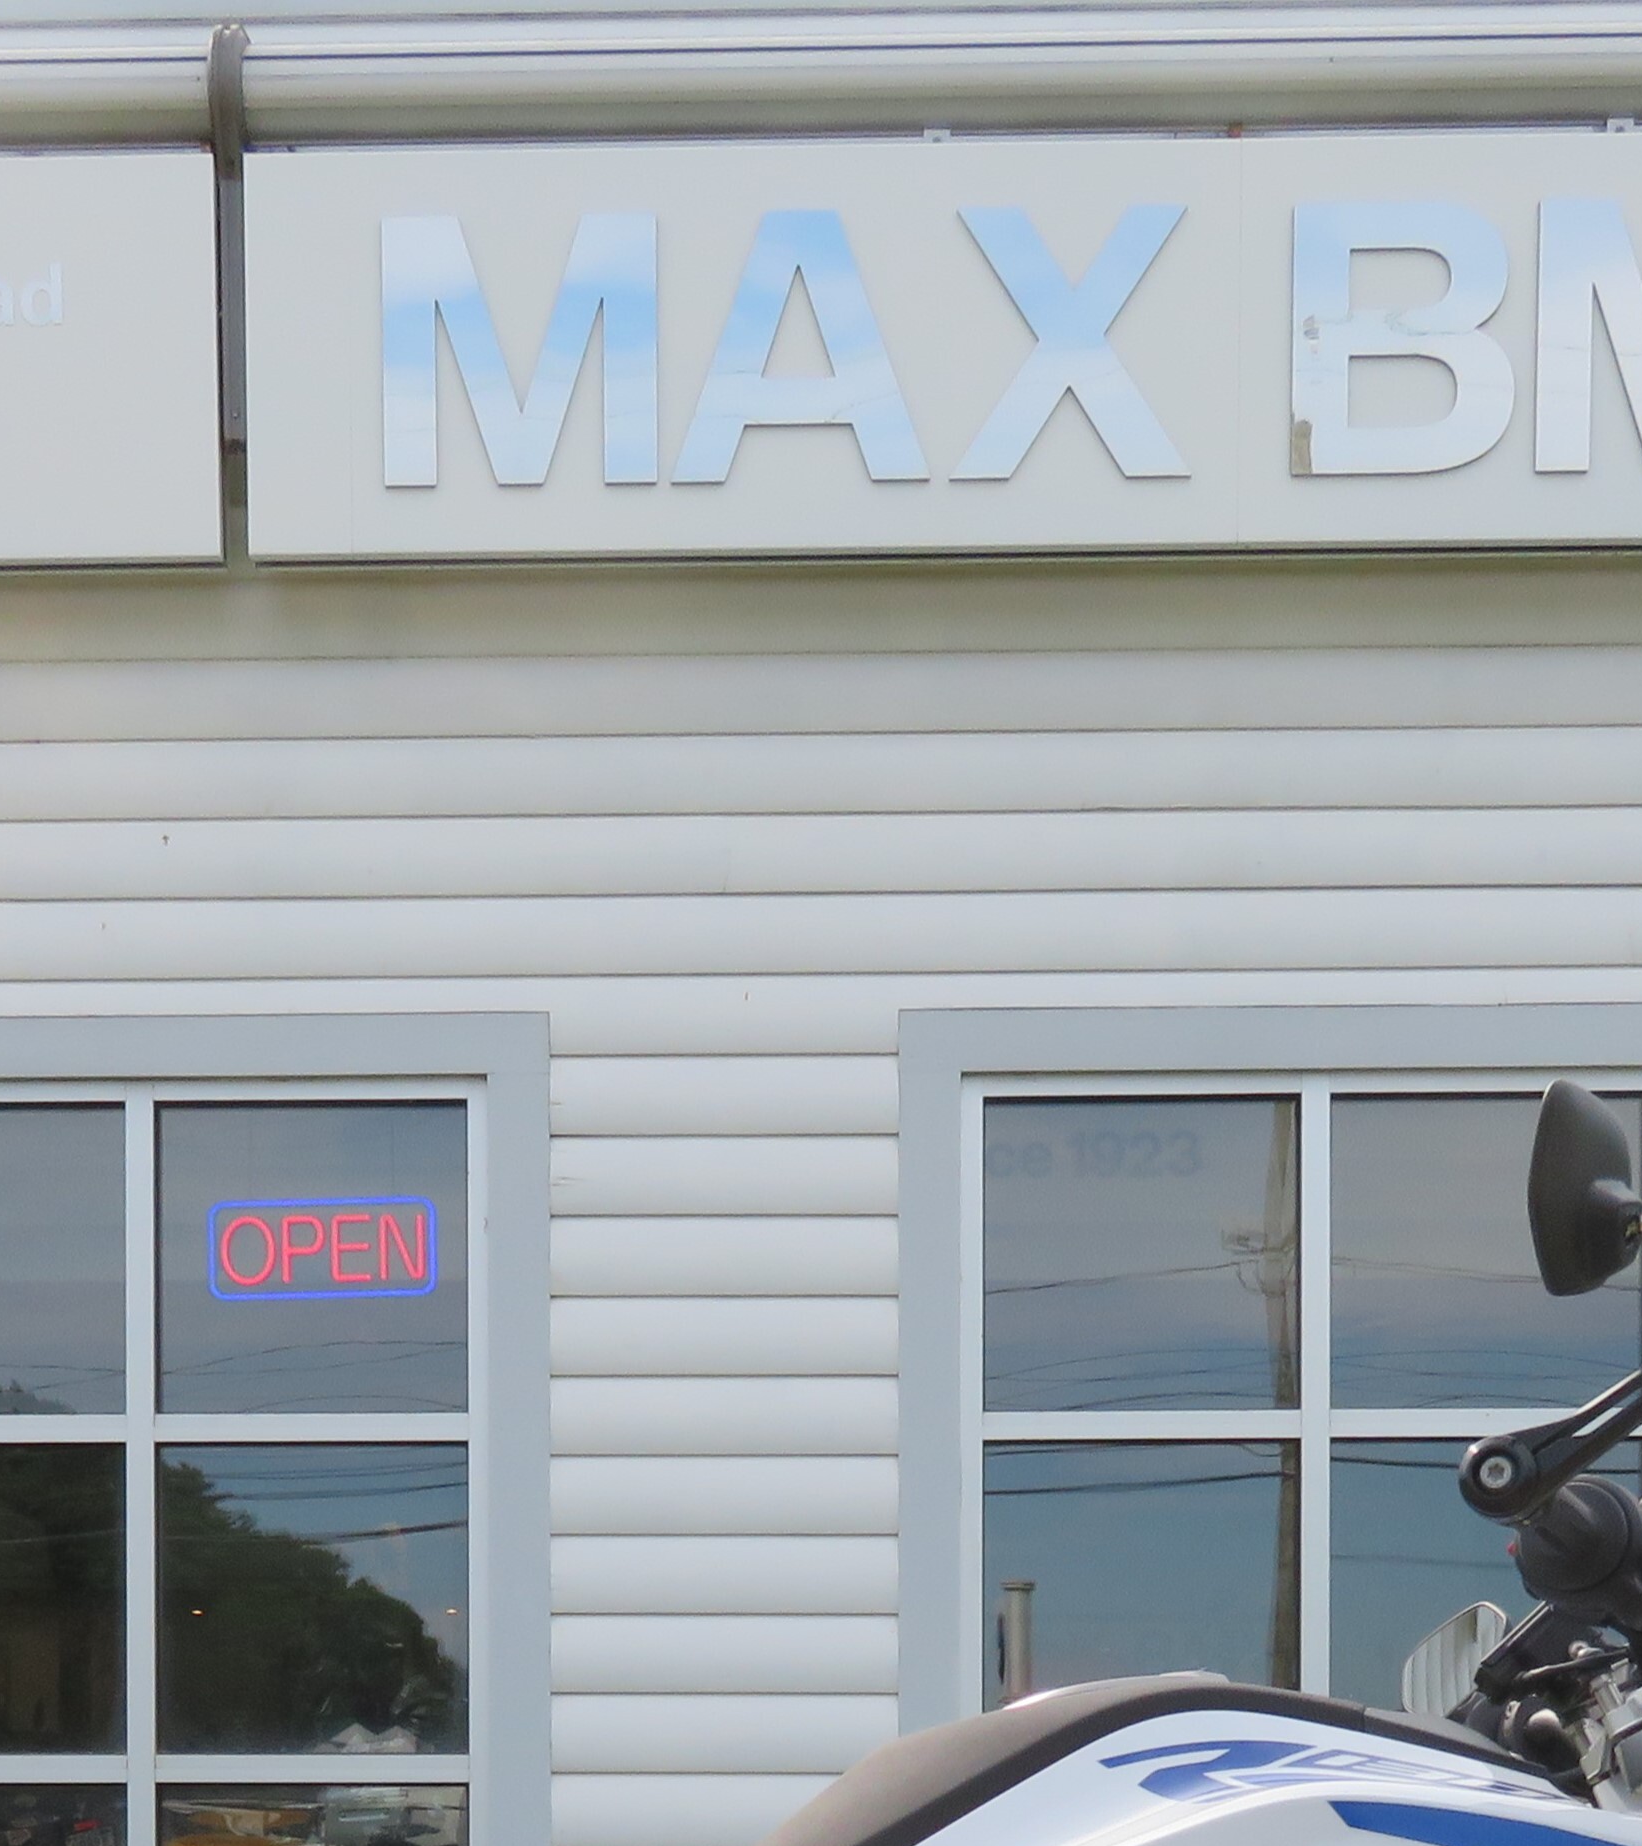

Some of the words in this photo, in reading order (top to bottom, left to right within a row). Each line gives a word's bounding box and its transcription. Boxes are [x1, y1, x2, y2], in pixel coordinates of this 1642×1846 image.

[380, 203, 1192, 488] MAX
[1065, 1128, 1205, 1179] 1923
[220, 1212, 426, 1287] OPEN
